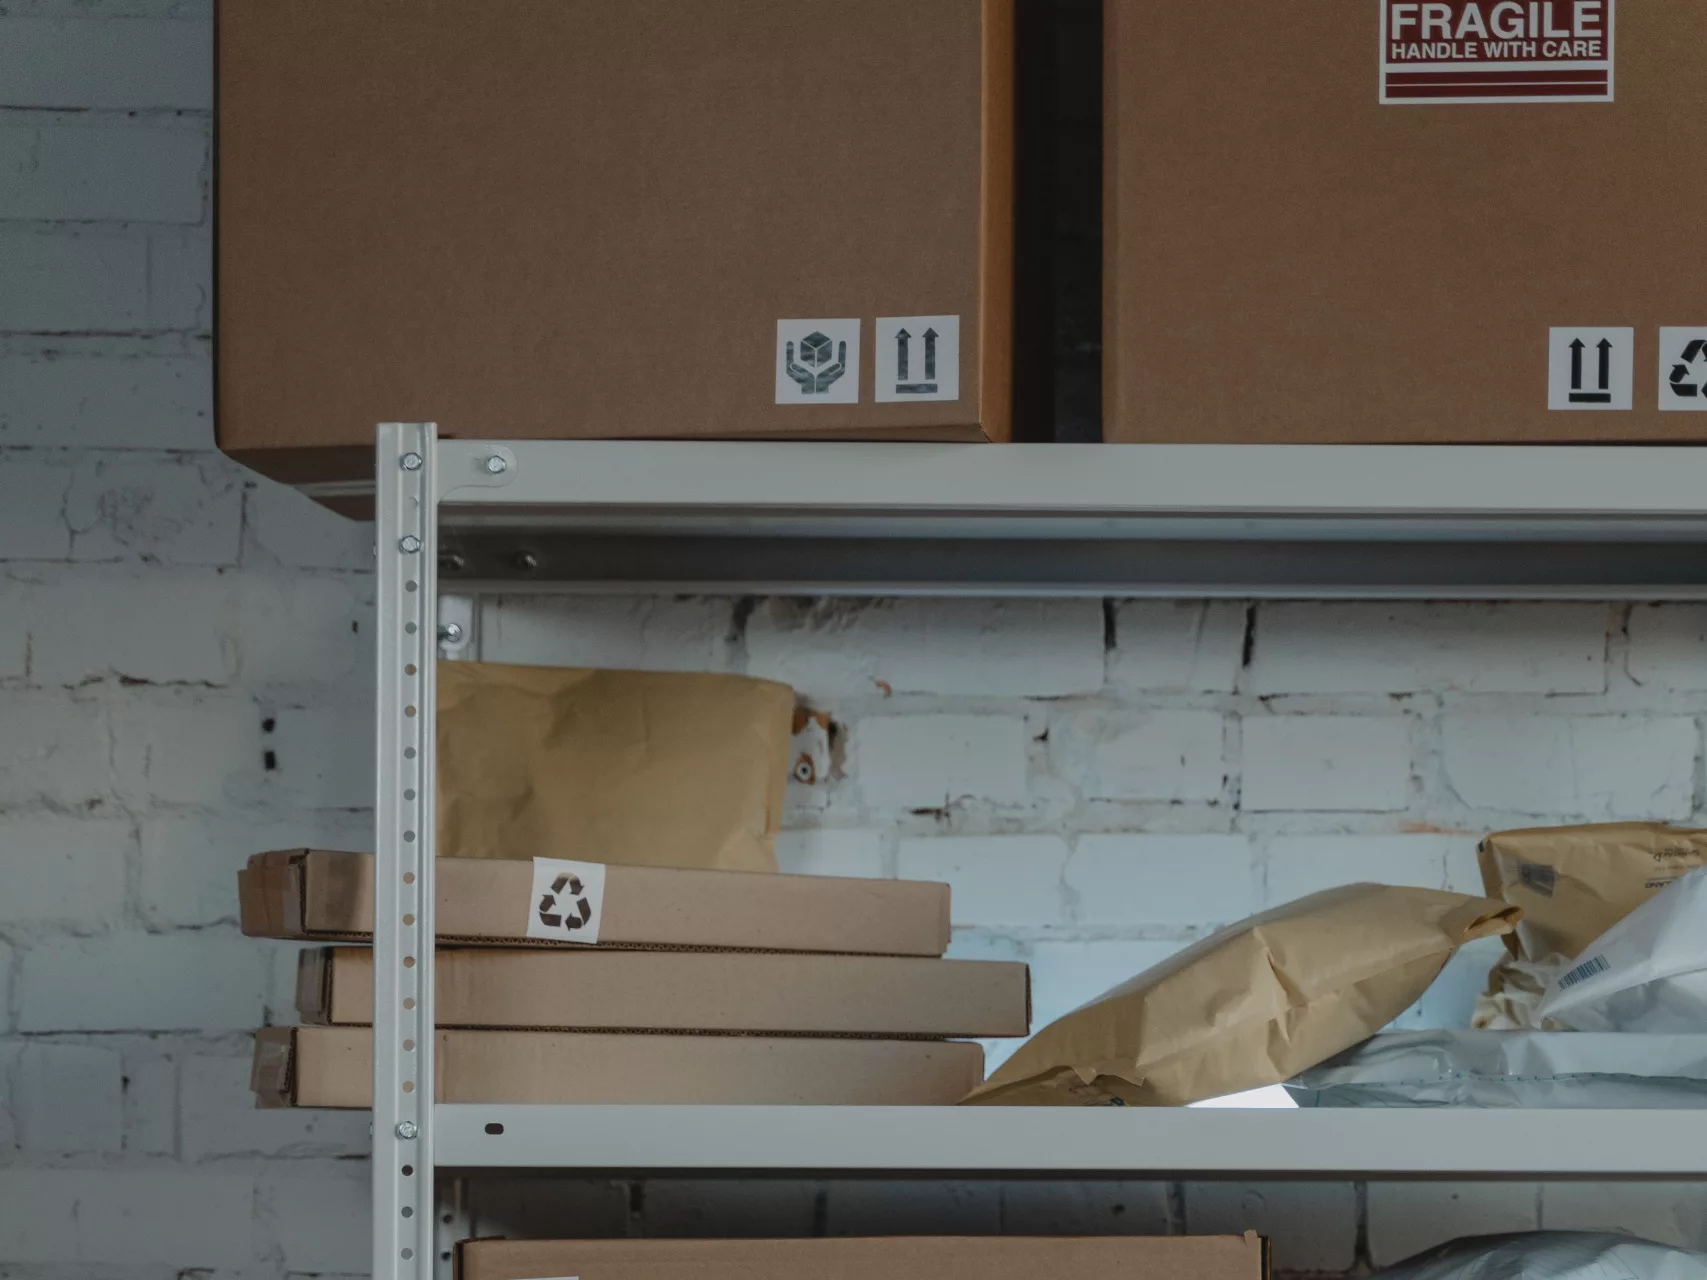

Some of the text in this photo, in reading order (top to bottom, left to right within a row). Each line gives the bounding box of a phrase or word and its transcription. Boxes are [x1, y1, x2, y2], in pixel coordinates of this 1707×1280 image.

[1391, 1, 1602, 40] FRAGILE
[1392, 40, 1602, 60] HANDLE WITH CARE
